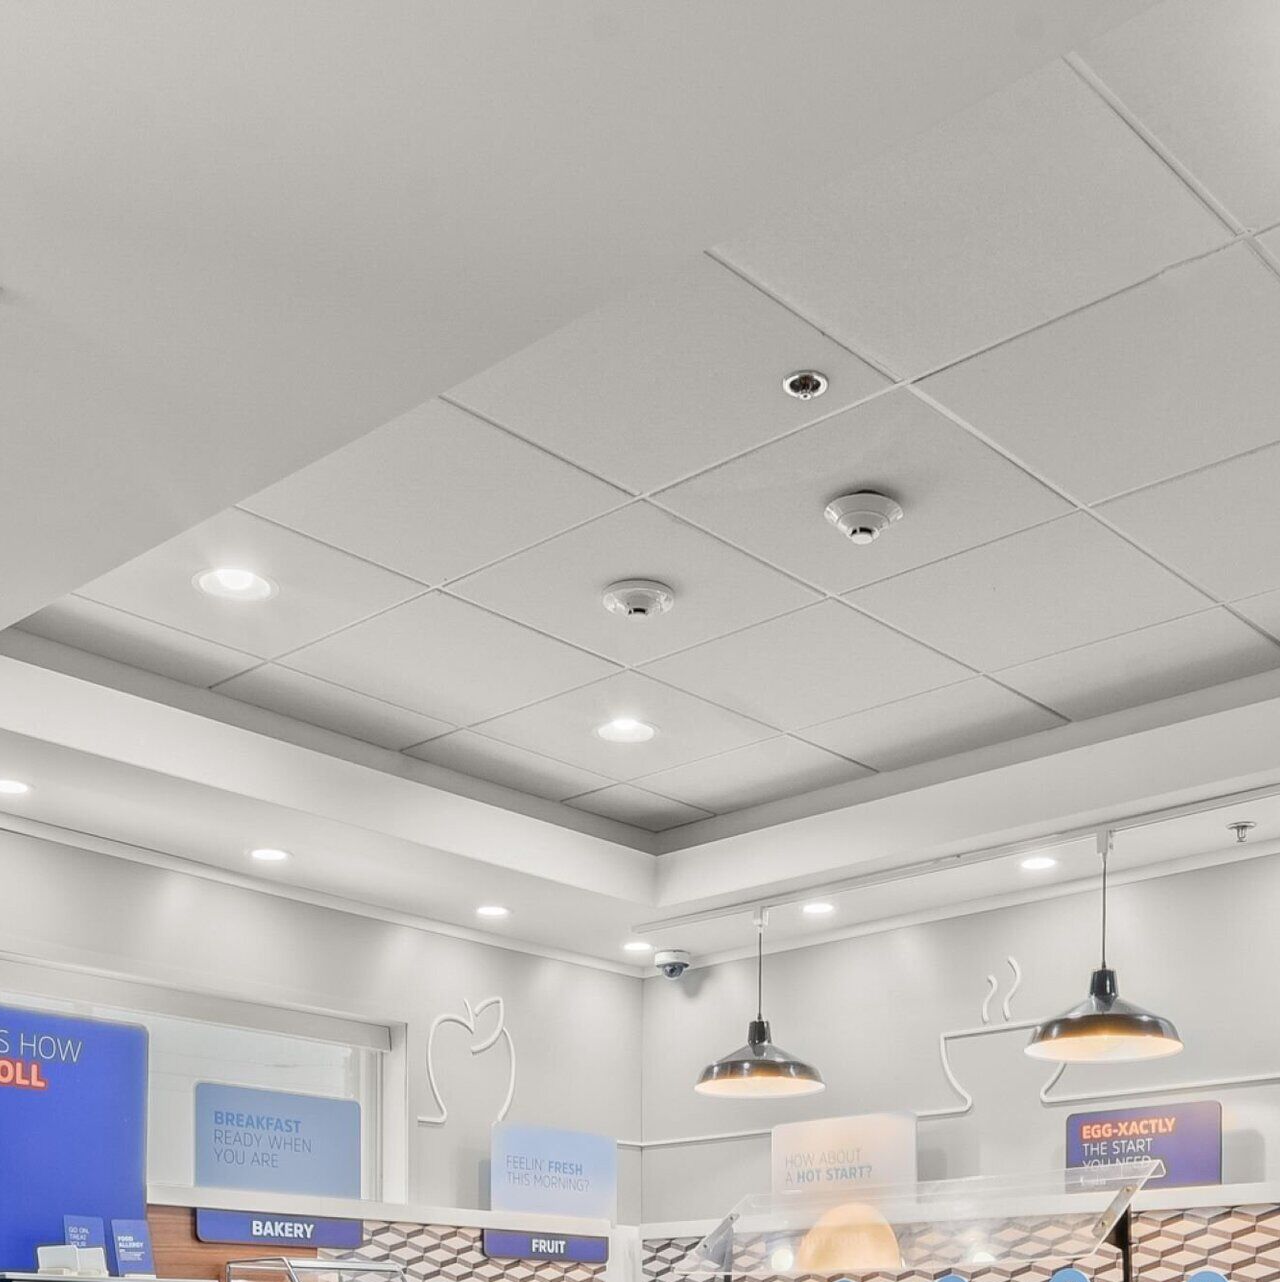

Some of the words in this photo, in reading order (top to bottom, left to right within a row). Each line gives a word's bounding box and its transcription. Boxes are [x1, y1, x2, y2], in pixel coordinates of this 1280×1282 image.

[19, 1032, 83, 1063] HOW
[213, 1110, 302, 1133] BREAKFAST
[1081, 1117, 1177, 1140] EGG-XACTLY
[213, 1128, 262, 1148] READY
[268, 1134, 312, 1153] WHEN
[1082, 1141, 1108, 1156] THE
[1112, 1138, 1153, 1155] START
[213, 1146, 246, 1166] YOU
[250, 1151, 281, 1169] ARE
[548, 1160, 584, 1176] FRESH
[785, 1150, 816, 1169] HOW
[820, 1147, 862, 1166] ABOUT
[507, 1171, 531, 1187] THIS
[533, 1174, 591, 1193] MORNING?
[785, 1171, 794, 1184] A
[797, 1169, 822, 1184] HOT
[826, 1165, 873, 1181] START?
[252, 1220, 315, 1239] BAKERY
[532, 1238, 566, 1254] FRUIT
